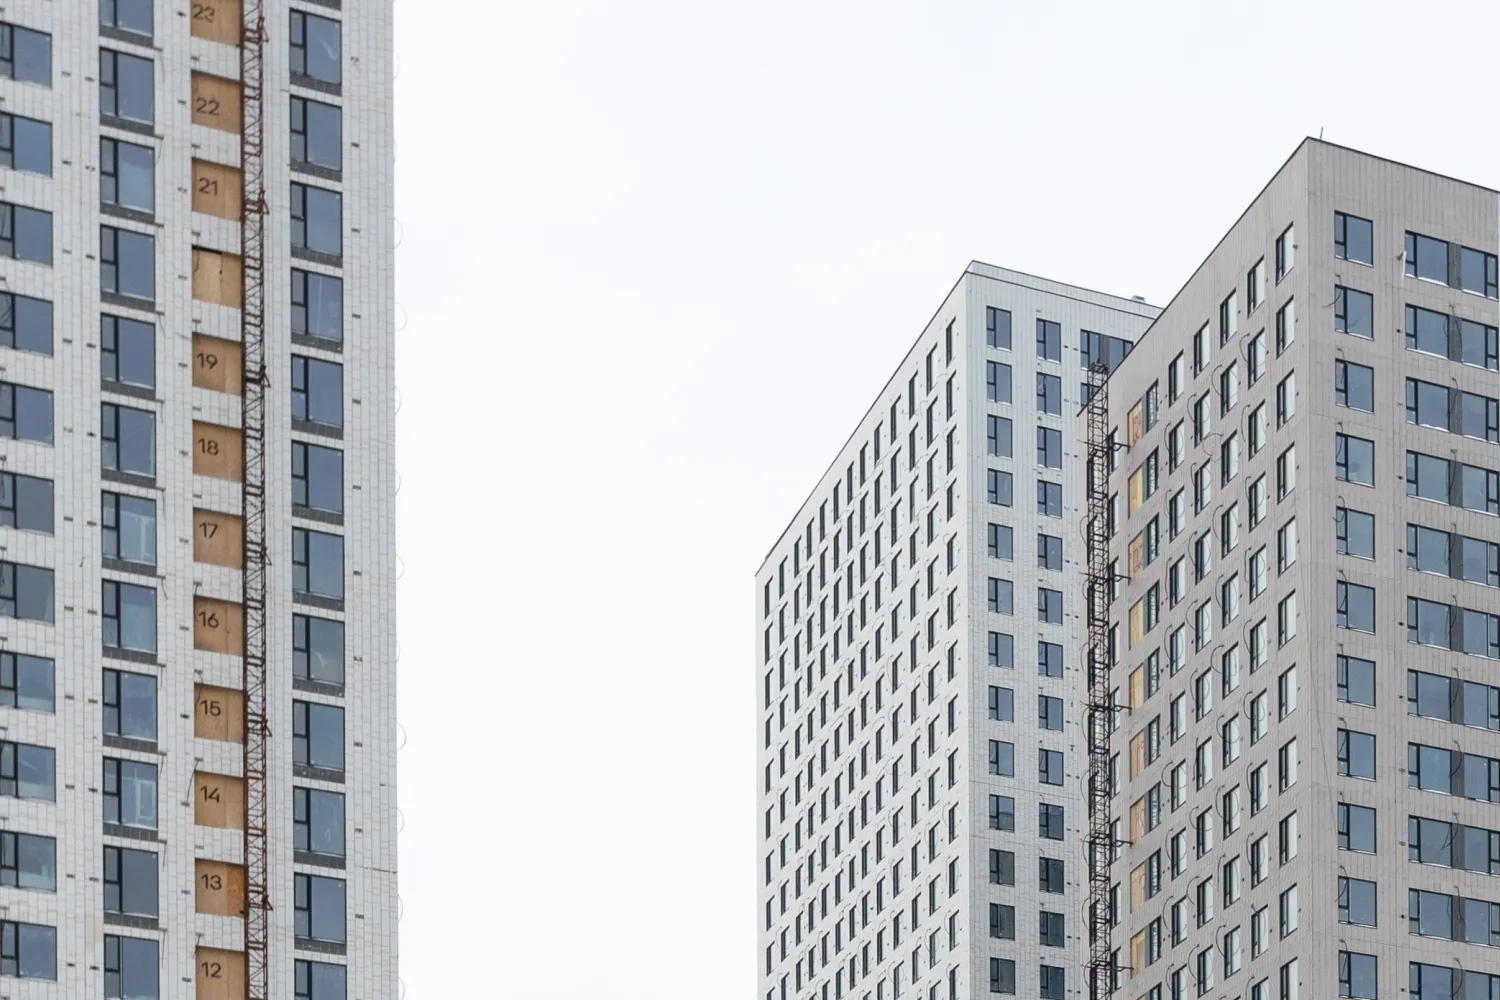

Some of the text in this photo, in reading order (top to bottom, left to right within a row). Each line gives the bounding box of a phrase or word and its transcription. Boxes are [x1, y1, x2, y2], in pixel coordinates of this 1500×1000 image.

[197, 98, 219, 115] 22
[199, 178, 217, 196] 21
[197, 353, 217, 369] 19
[199, 439, 218, 455] 18
[200, 522, 218, 538] 17
[199, 612, 218, 627] 16
[200, 700, 221, 716] 15
[201, 786, 219, 803] 14
[202, 874, 221, 891] 13
[202, 962, 221, 978] 12
